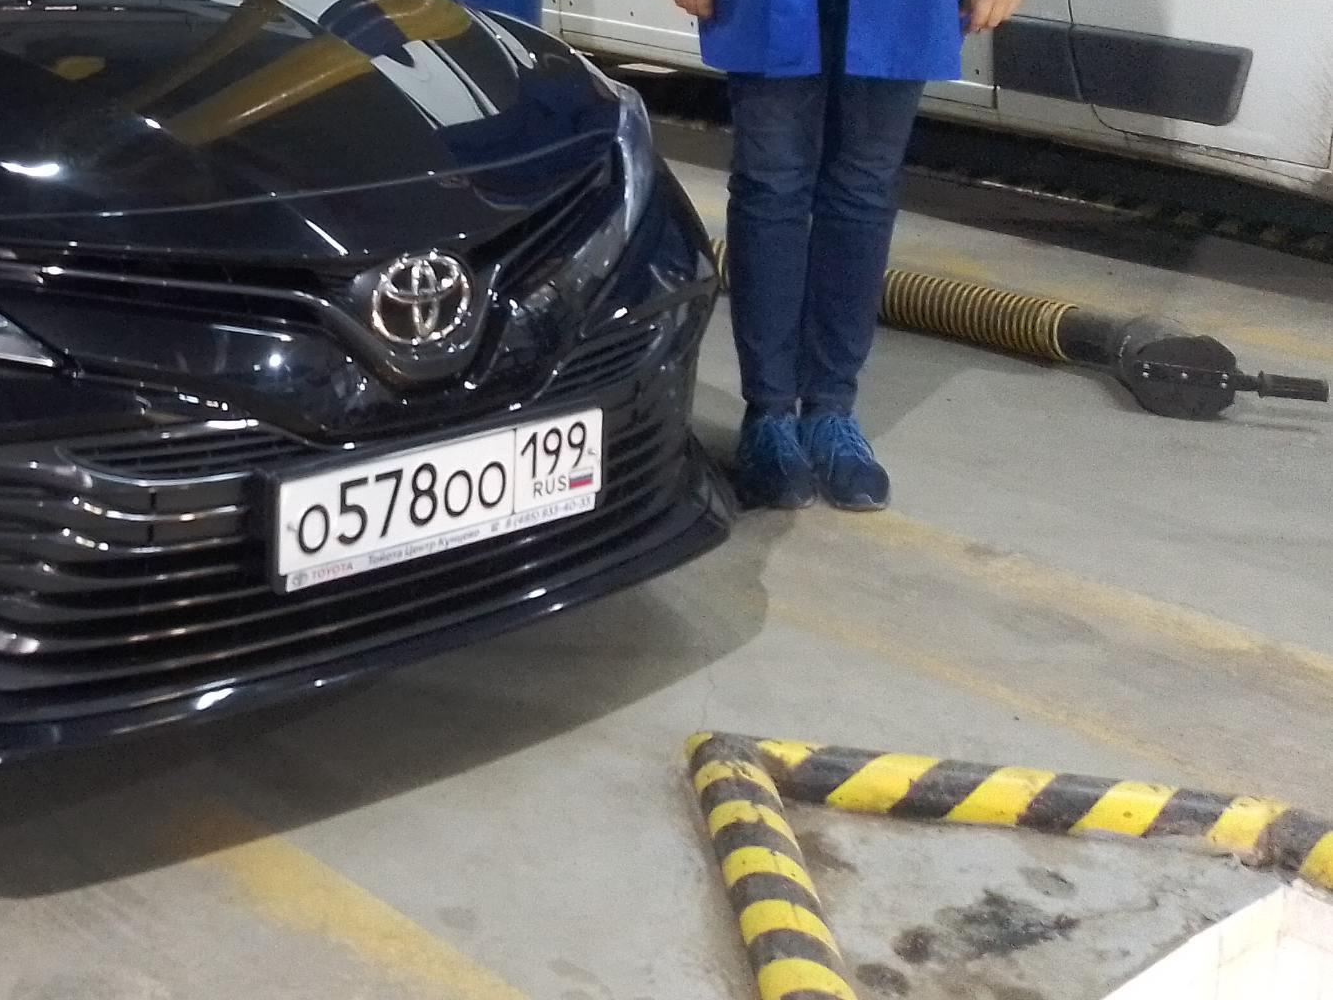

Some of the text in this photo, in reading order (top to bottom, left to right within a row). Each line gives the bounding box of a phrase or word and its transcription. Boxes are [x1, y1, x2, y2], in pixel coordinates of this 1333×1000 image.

[520, 421, 587, 480] 199
[532, 475, 568, 498] RUS
[311, 561, 354, 580] TOYOTA
